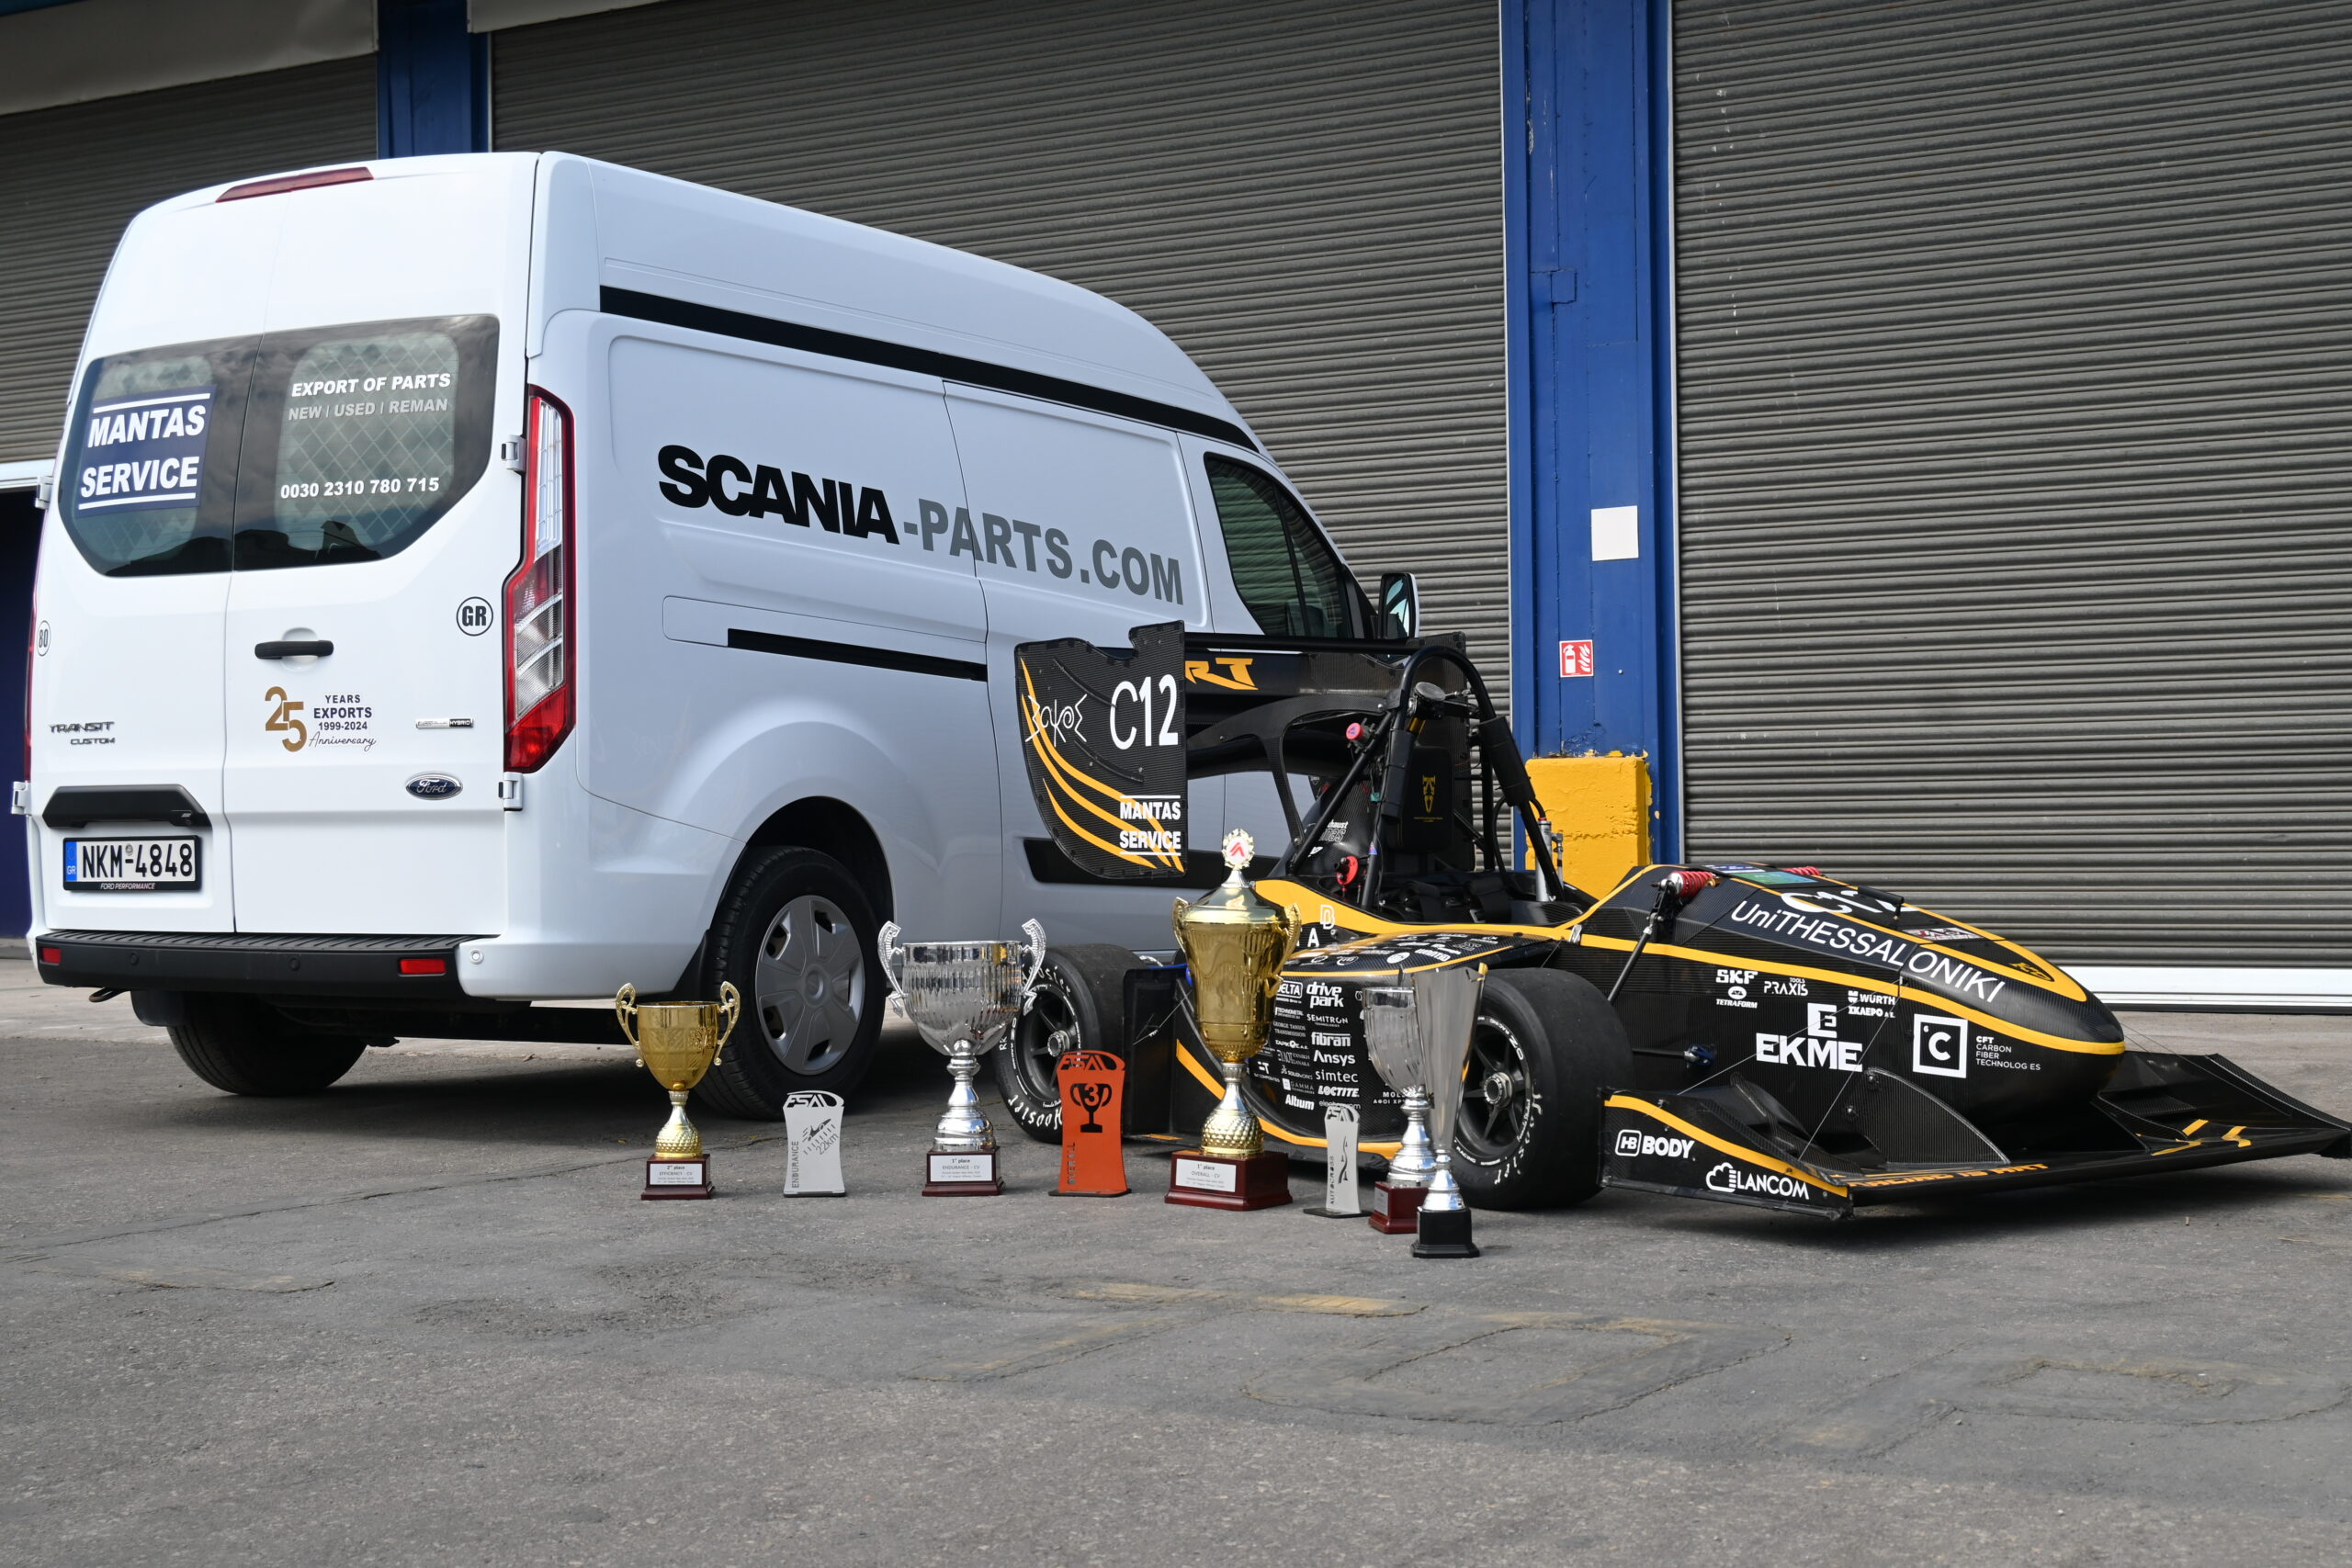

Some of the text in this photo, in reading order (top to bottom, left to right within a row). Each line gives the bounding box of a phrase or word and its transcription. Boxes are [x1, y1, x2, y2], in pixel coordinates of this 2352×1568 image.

[291, 373, 451, 397] EXPORT OF PARTS
[288, 406, 322, 421] NEW
[334, 402, 376, 417] USED
[389, 399, 448, 413] REMAN
[87, 404, 206, 448] MANTAS
[80, 456, 200, 498] SERVICE
[280, 477, 440, 499] 0030 2310 780 715
[657, 444, 1184, 606] SCANIA-PARTS.COM
[462, 605, 487, 626] GR
[39, 628, 49, 648] 80
[324, 694, 361, 704] YEARS
[265, 686, 308, 752] 25
[313, 706, 372, 719] EXPORTS
[1110, 673, 1179, 750] C12
[50, 721, 115, 733] TRANSIT
[318, 721, 368, 731] 1999-2024
[309, 731, 377, 752] Anniversary
[416, 777, 448, 795] Ford
[1119, 801, 1182, 820] MANTAS
[1119, 830, 1182, 850] SERVICE
[66, 865, 76, 874] GR
[82, 843, 193, 878] NKM-4848
[1731, 900, 2007, 1003] UniTHESSALONIKI
[1715, 969, 1758, 985] SKF
[1306, 981, 1342, 997] drive
[1764, 980, 1808, 996] PRAXIS
[1309, 994, 1344, 1009] park
[1715, 998, 1758, 1009] TETRAFORM
[1306, 1013, 1348, 1024] SEMITRON
[1311, 1032, 1351, 1047] fibran
[1928, 1032, 1951, 1061] C
[1975, 1035, 1995, 1044] CFT
[1975, 1043, 2012, 1053] CARBON
[1313, 1049, 1356, 1067] Ansys
[1756, 1032, 1863, 1073] EKME
[1975, 1051, 2000, 1059] FIBER
[1315, 1069, 1359, 1083] simtec
[1084, 1082, 1100, 1107] 3
[1284, 1094, 1315, 1111] Altium
[815, 1133, 839, 1156] 22km
[1620, 1135, 1695, 1158] HB BODY
[791, 1140, 799, 1189] ENDURANCE
[1736, 1170, 1810, 1200] LANCOM
